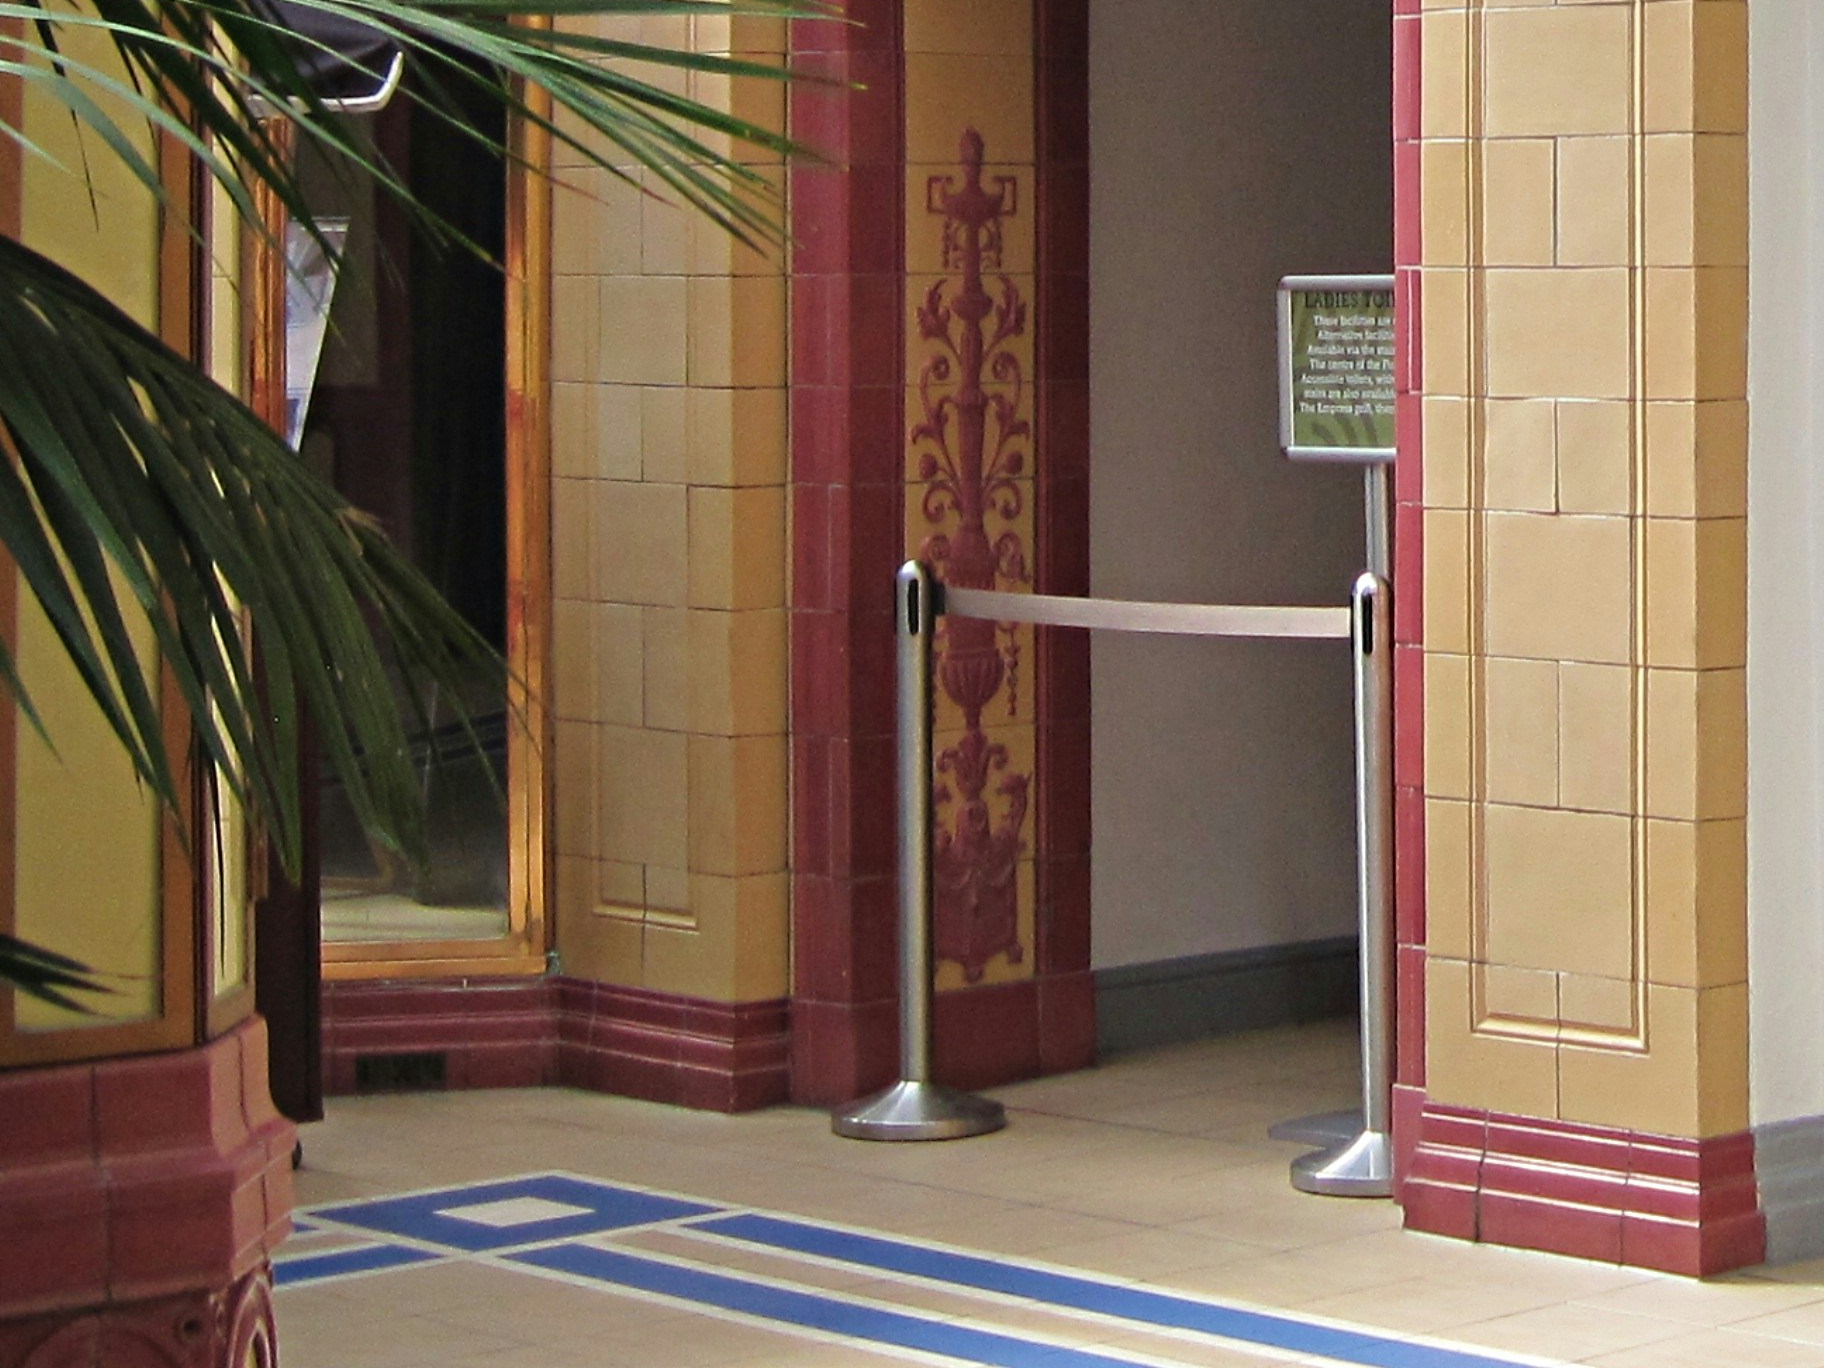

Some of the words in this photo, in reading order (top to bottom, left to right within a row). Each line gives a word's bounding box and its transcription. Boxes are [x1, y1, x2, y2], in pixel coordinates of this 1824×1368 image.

[1305, 291, 1359, 308] LADIES
[1309, 358, 1326, 370] The
[1299, 402, 1315, 413] The
